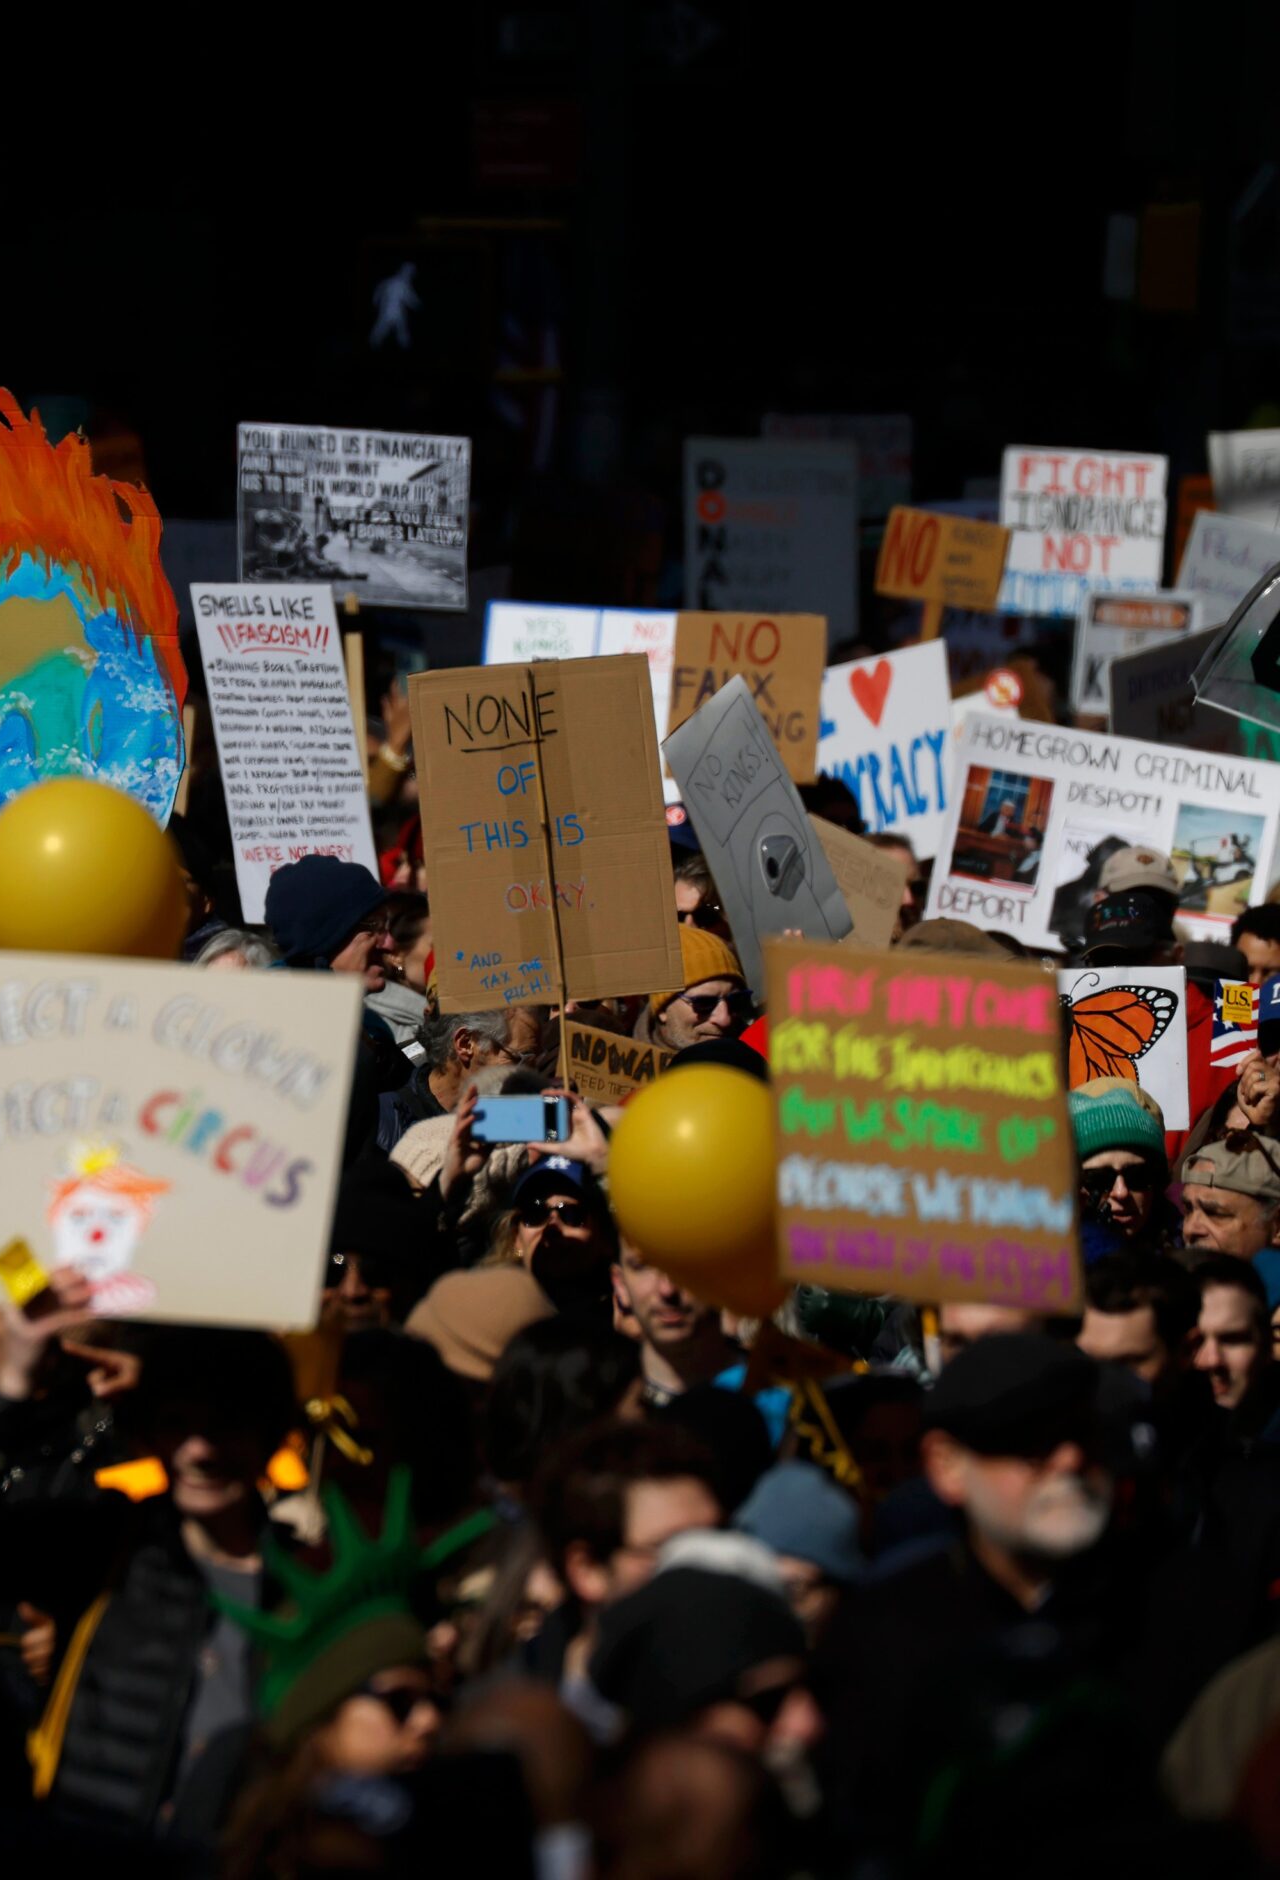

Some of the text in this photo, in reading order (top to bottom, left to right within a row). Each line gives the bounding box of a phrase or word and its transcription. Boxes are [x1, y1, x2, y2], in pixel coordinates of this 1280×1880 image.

[242, 430, 462, 461] YOU RUINED US FINANCIALLY
[331, 480, 376, 498] WORLD
[381, 483, 409, 500] WAR
[1018, 456, 1155, 498] FIGHT
[1009, 491, 1164, 538] IGNORANCE
[879, 513, 940, 588] NO
[1042, 533, 1123, 576] NOT
[198, 594, 316, 621] SMELLS LIKE
[632, 619, 668, 641] NO
[708, 619, 781, 667] NO
[672, 666, 777, 710] FAX
[444, 690, 558, 745] NONE
[496, 761, 536, 796] OF
[693, 752, 724, 800] NO
[973, 721, 1264, 799] HOMEGROWN CRIMINAL
[1068, 781, 1163, 816] DESPOT!
[460, 813, 585, 853] THIS IS
[288, 846, 309, 861] NOT
[503, 880, 595, 913] OKAY.
[938, 883, 1032, 924] DEPORT
[470, 951, 502, 972] AND
[480, 970, 510, 990] TAX
[1225, 988, 1251, 1008] U.S.
[151, 993, 331, 1112] CLOWN
[574, 1071, 605, 1091] FEED
